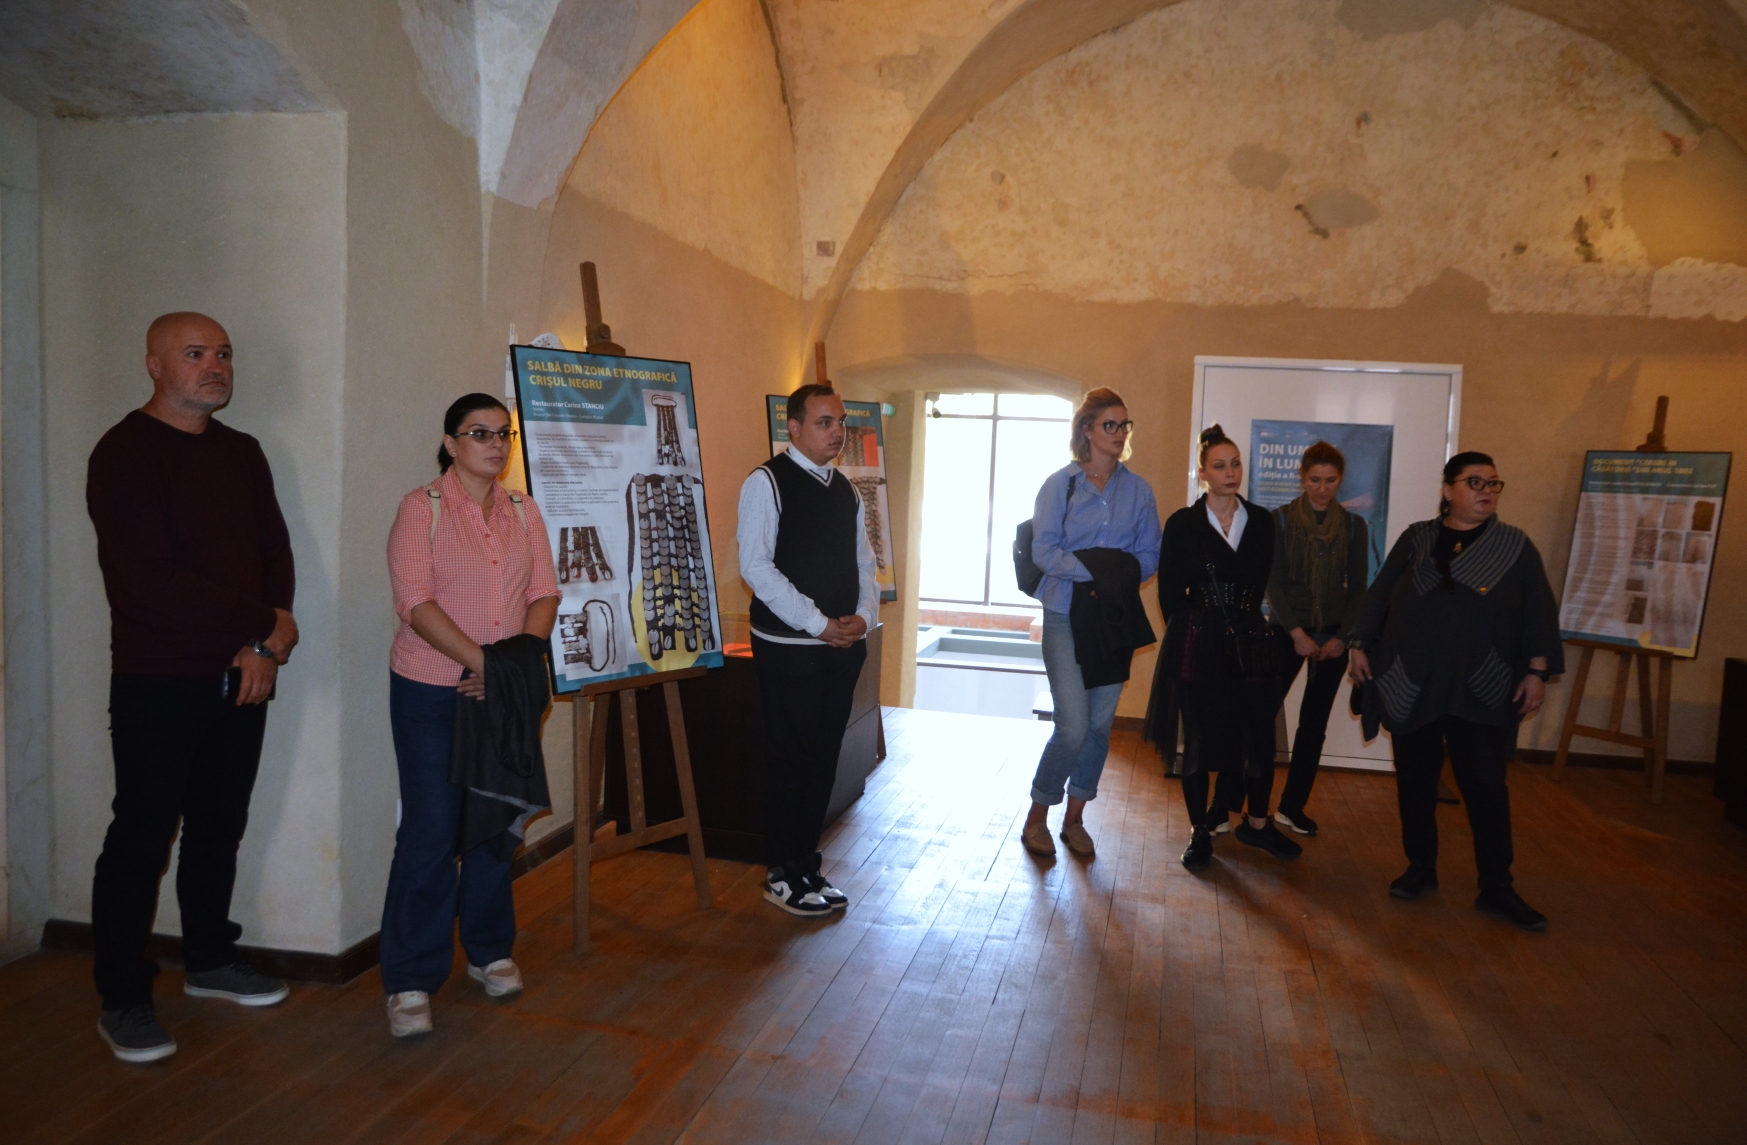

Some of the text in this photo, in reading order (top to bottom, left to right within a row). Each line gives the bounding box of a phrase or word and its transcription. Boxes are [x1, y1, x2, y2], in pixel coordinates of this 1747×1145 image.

[527, 360, 678, 383] SALBĂ DIN ZONA ETNOGRAFICĂ
[529, 374, 603, 390] CRIȘUL NEGRU
[531, 399, 605, 410] Restaurator Carina STANCIU
[1259, 443, 1285, 455] DIN
[1258, 455, 1273, 469] ÎN
